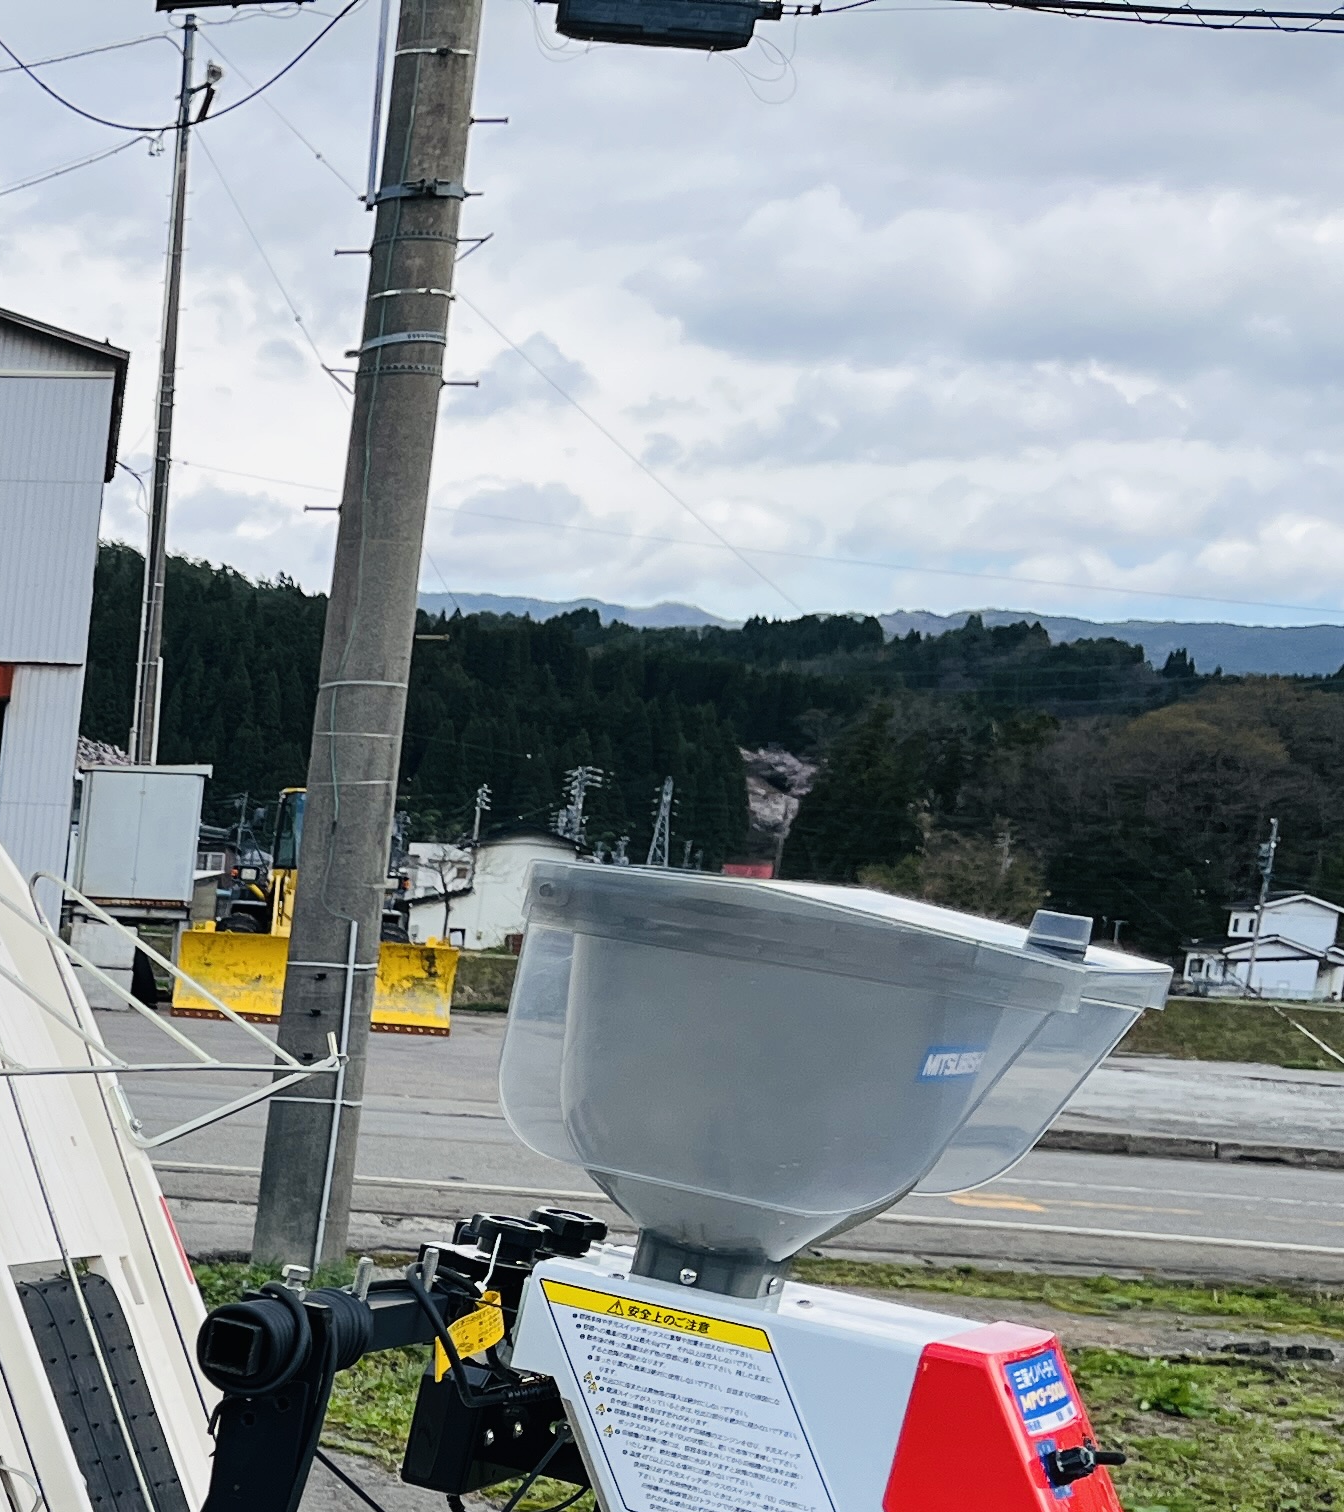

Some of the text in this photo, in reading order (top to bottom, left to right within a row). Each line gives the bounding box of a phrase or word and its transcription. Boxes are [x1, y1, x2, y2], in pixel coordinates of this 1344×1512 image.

[627, 1306, 711, 1334] 安全上のご注意
